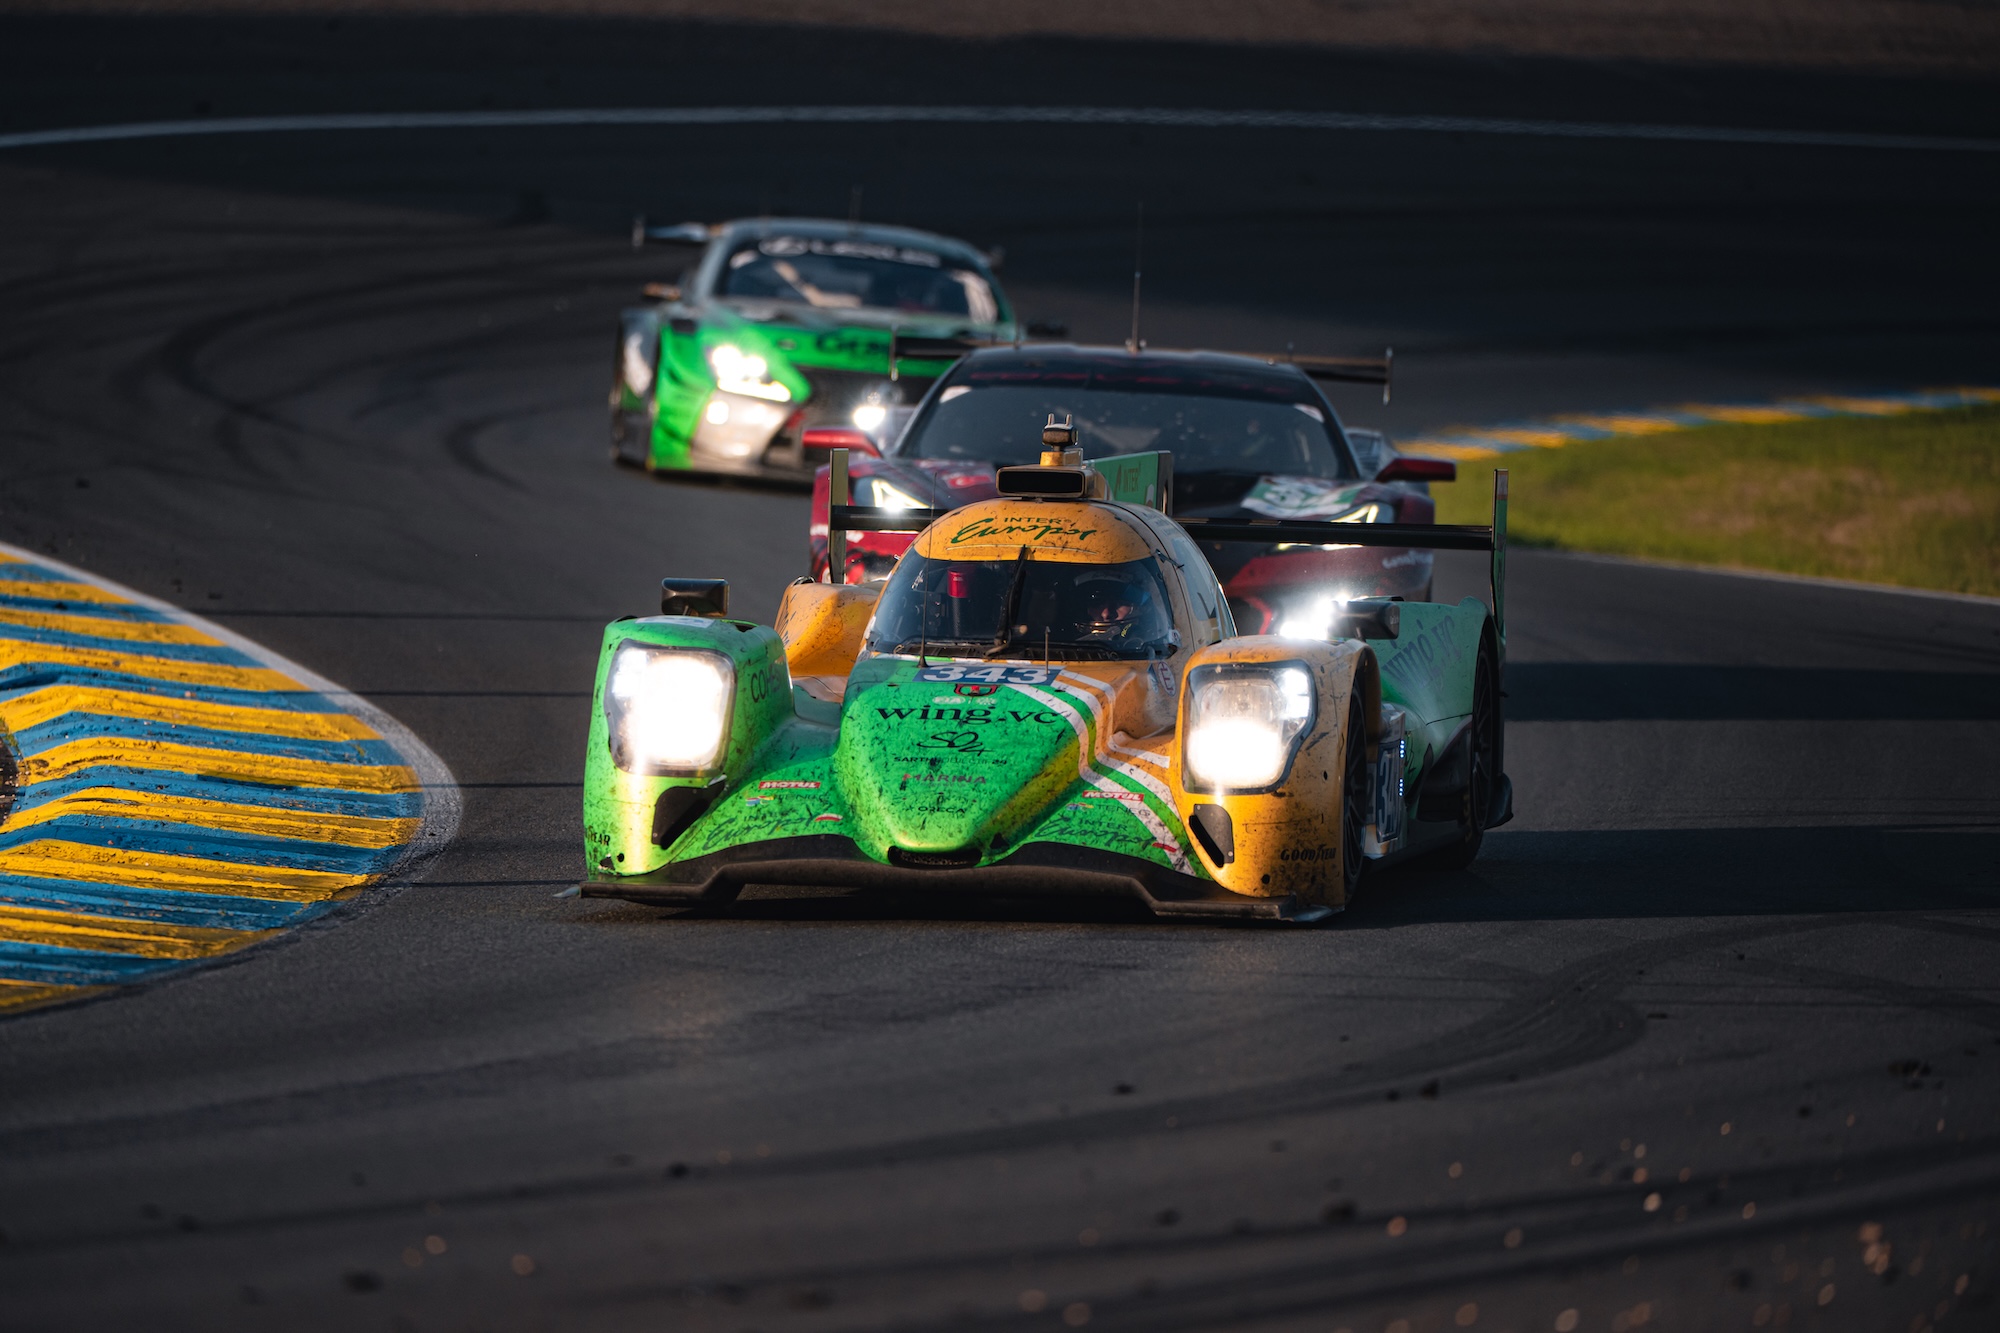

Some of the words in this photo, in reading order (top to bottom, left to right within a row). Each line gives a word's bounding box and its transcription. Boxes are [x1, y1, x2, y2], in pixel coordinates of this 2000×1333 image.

[1004, 517, 1063, 525] INTER
[950, 517, 1098, 544] Europol
[922, 665, 1051, 685] 343
[876, 704, 1057, 725] wing.vc
[761, 781, 818, 789] MOTUL
[1084, 792, 1144, 801] MOTUL
